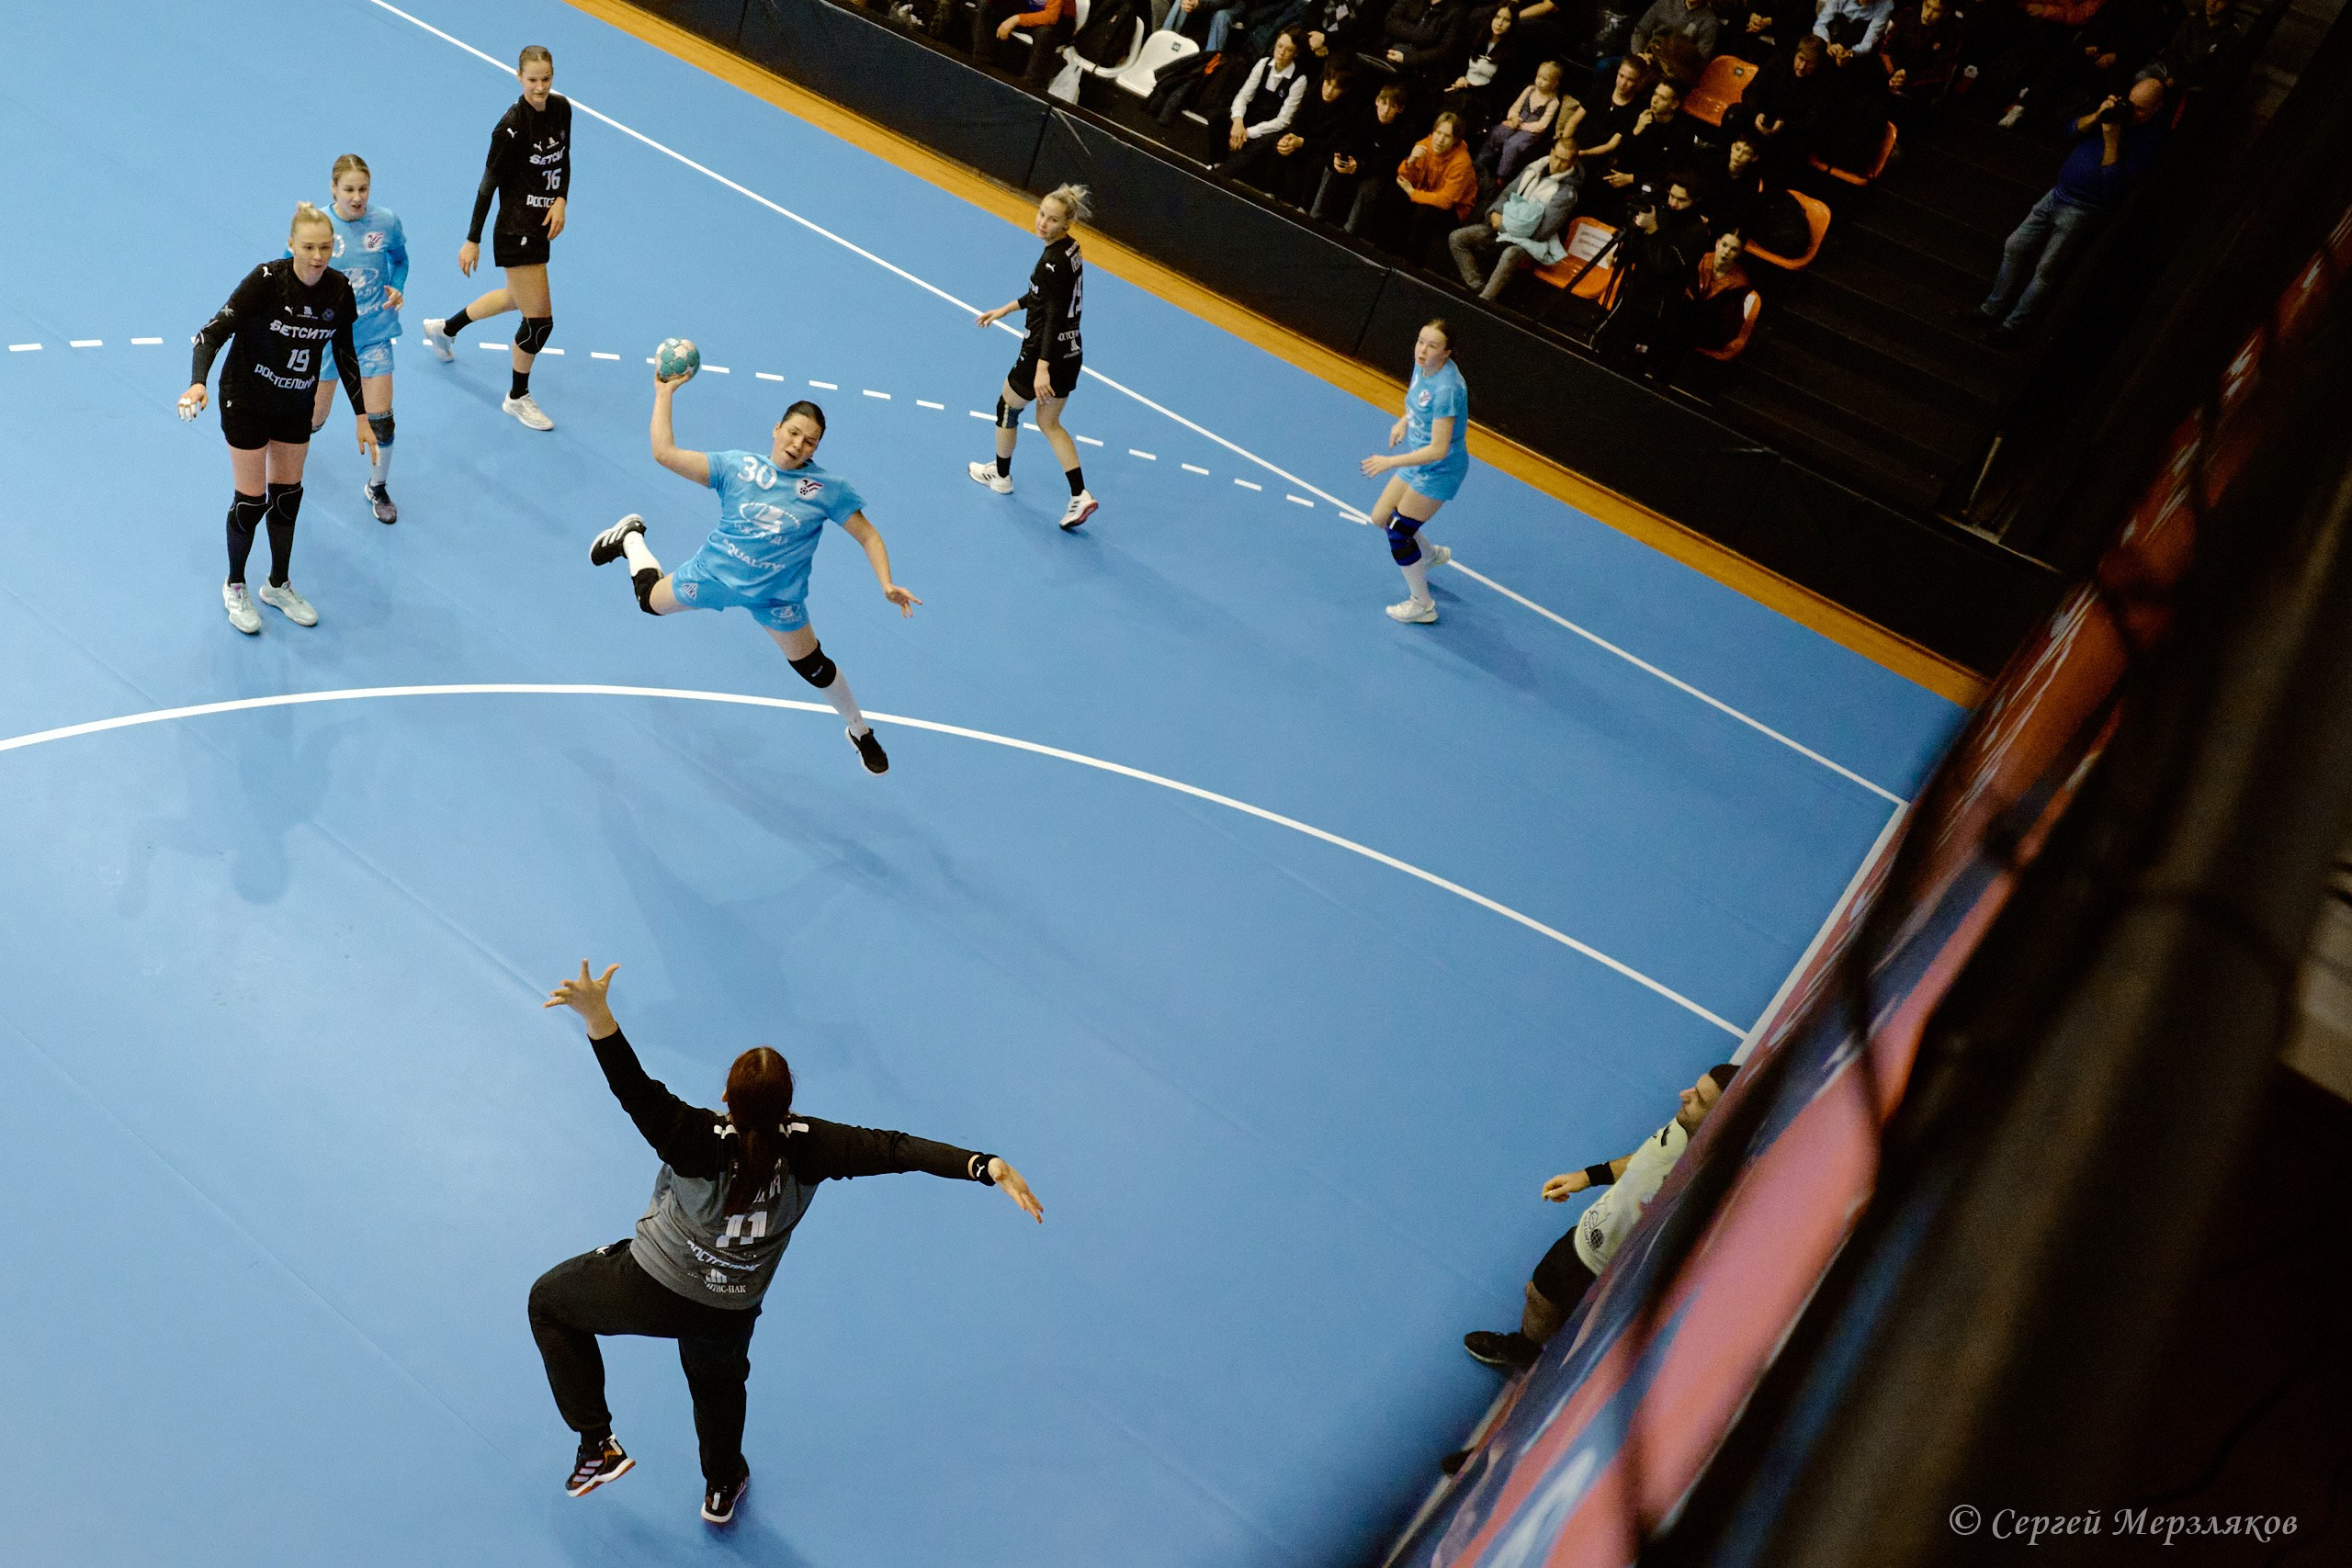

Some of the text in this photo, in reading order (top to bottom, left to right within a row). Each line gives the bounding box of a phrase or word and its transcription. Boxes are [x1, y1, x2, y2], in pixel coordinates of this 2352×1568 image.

[542, 168, 562, 191] 76
[269, 319, 337, 340] БЕТСИТИ
[286, 348, 311, 373] 19
[254, 363, 315, 390] РОСТСЕЛЬМ
[737, 456, 778, 491] 30
